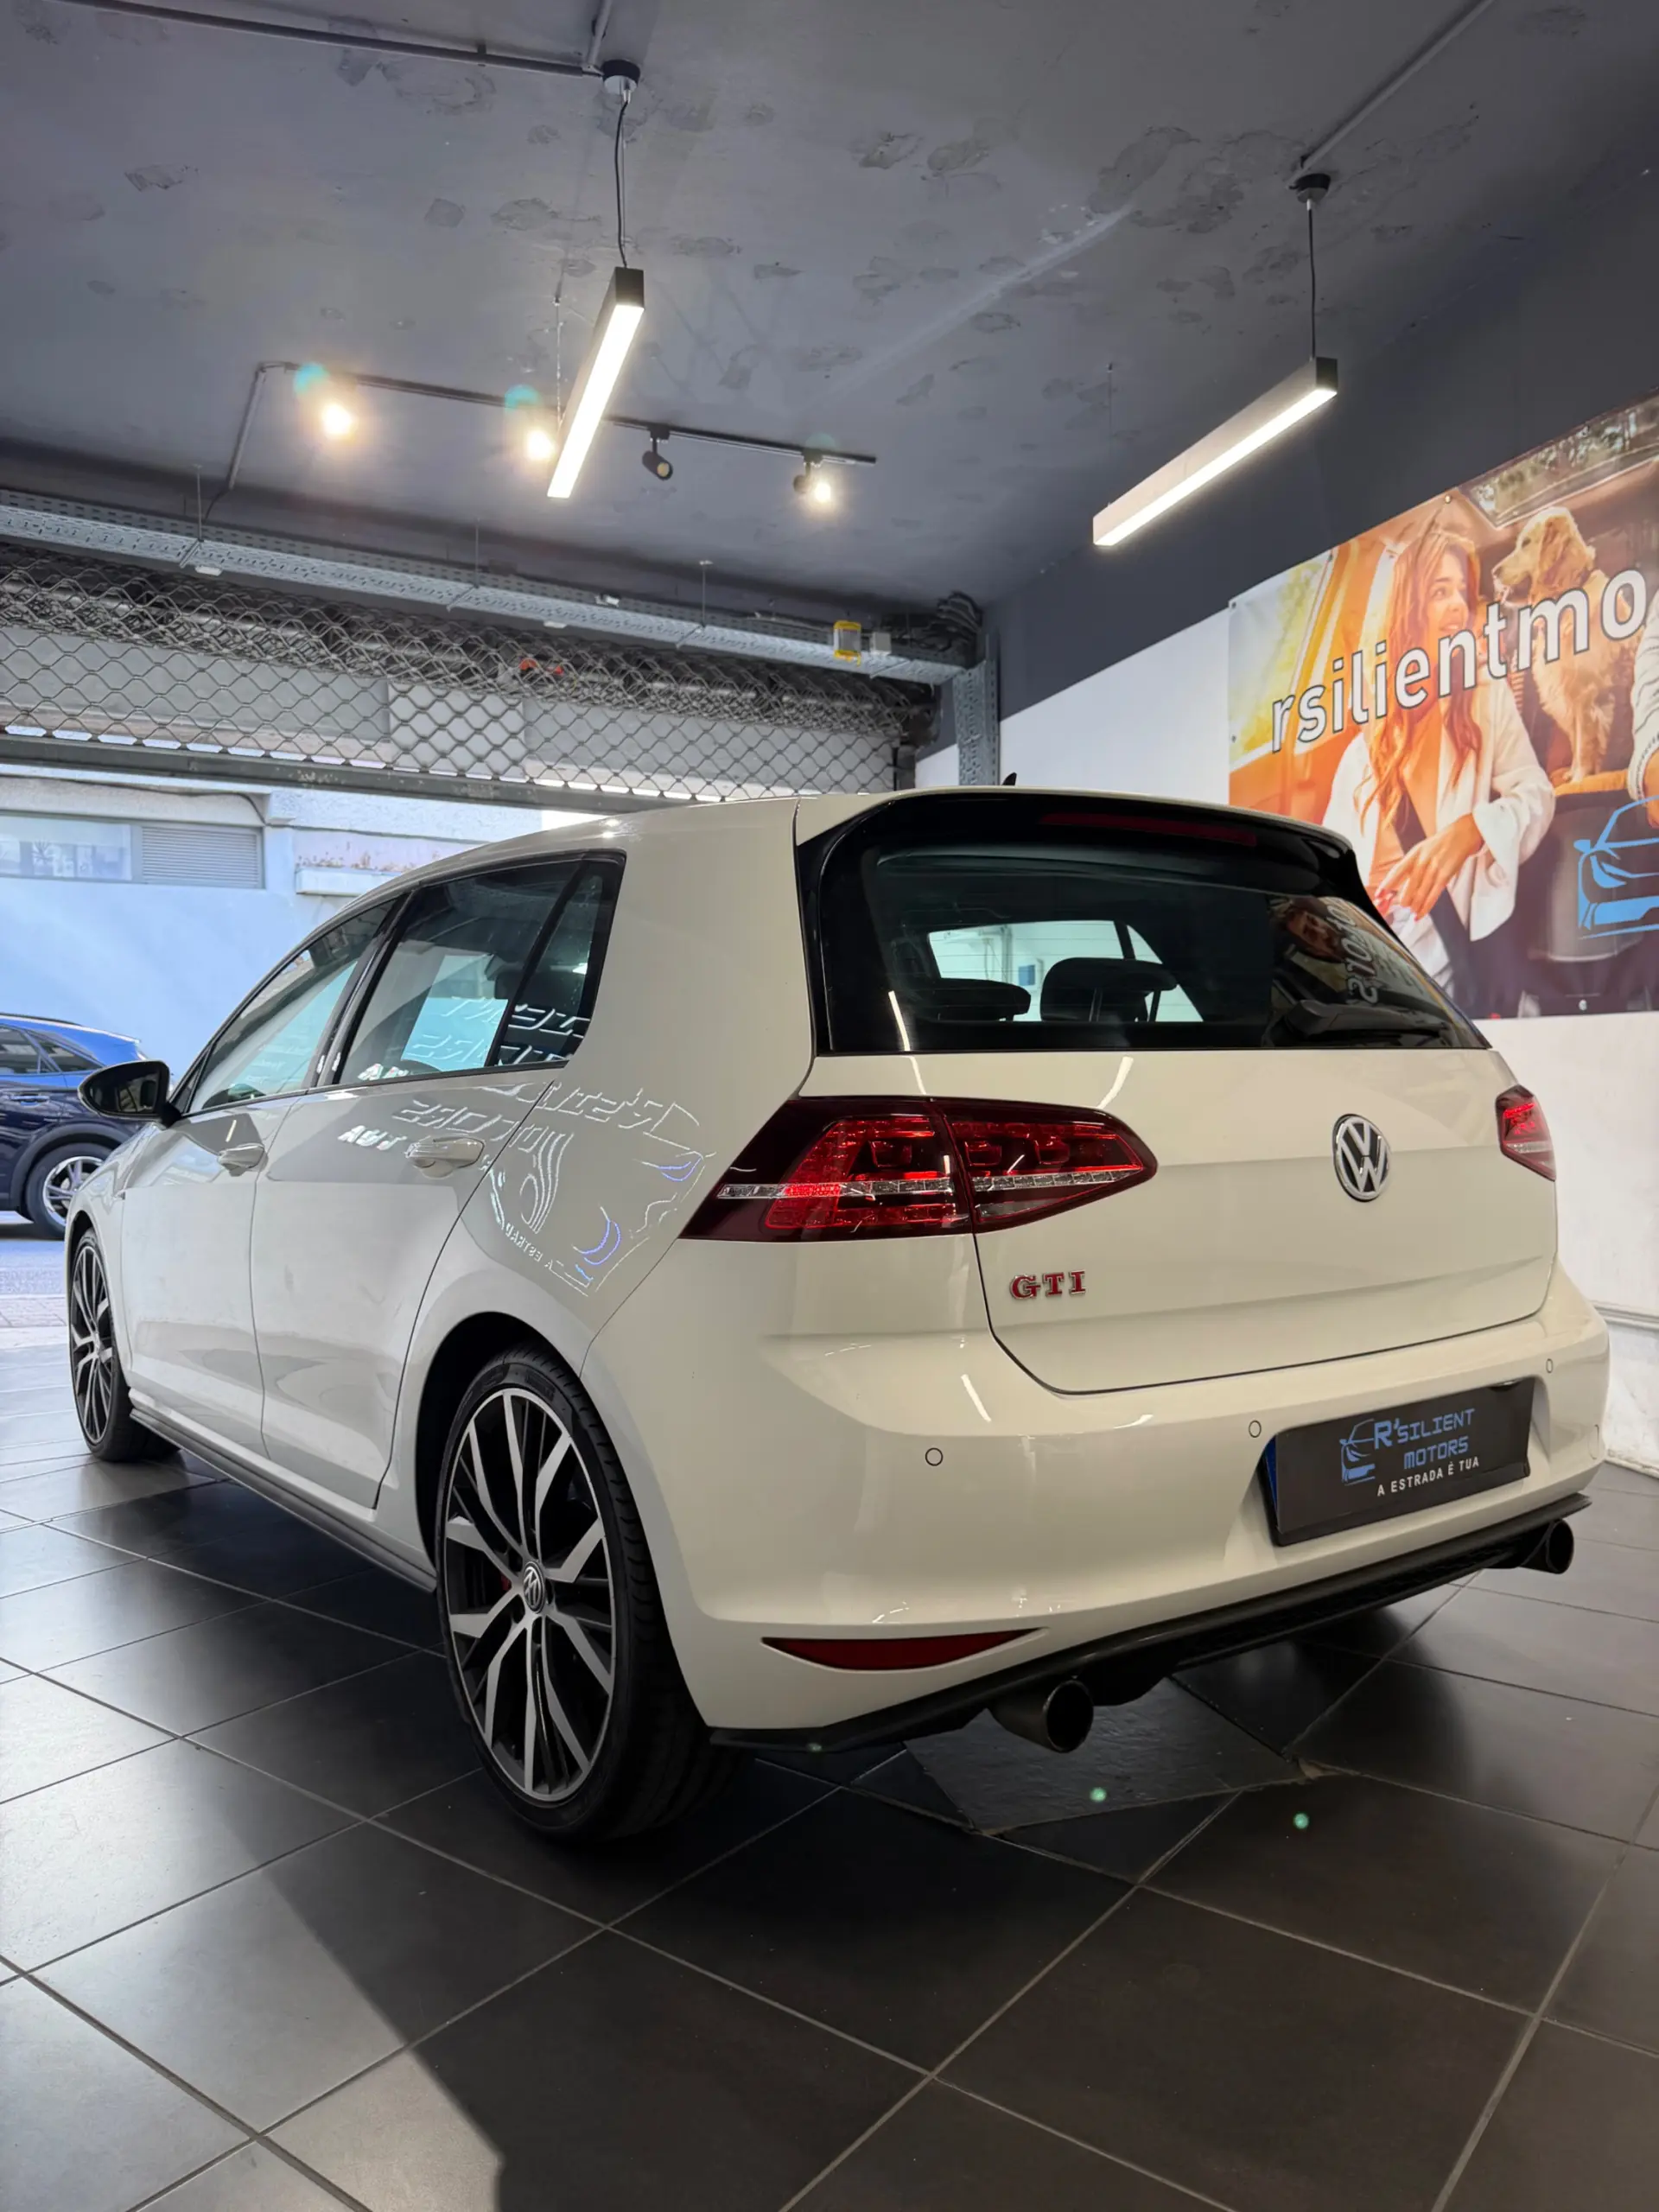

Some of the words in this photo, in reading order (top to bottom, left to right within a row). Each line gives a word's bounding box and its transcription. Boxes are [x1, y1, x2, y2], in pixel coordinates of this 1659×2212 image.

[1009, 1269, 1086, 1300] GTI
[1374, 1408, 1476, 1450] R'SILIENT
[1403, 1435, 1469, 1470] MOTORS
[1376, 1484, 1386, 1497] A
[1390, 1467, 1444, 1493] ESTRADA
[1459, 1456, 1480, 1472] TUA
